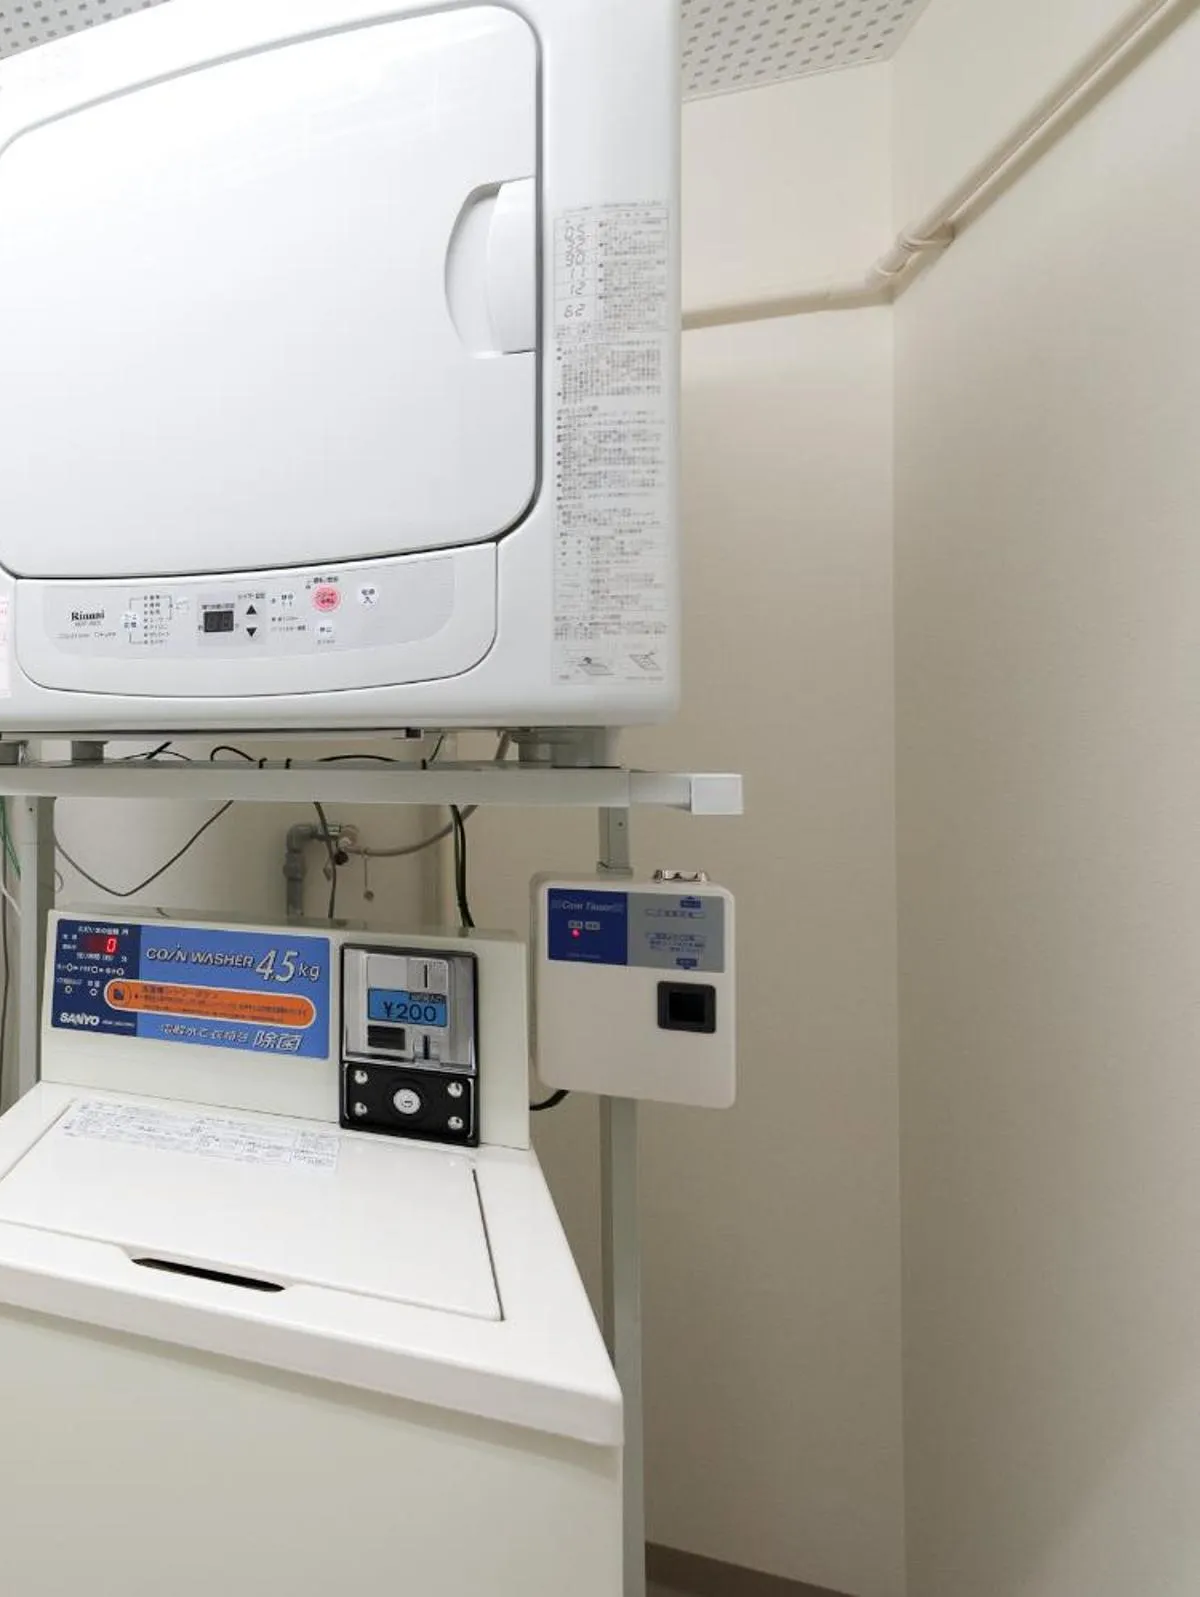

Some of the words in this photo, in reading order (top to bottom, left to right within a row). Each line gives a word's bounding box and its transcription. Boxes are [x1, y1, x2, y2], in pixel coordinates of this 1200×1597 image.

[569, 281, 586, 295] 12
[71, 609, 105, 621] Rinnai
[106, 937, 117, 953] 0
[146, 945, 188, 961] COIN
[190, 951, 255, 967] WASHER
[60, 1011, 100, 1026] SANYO
[383, 1001, 437, 1023] ¥200
